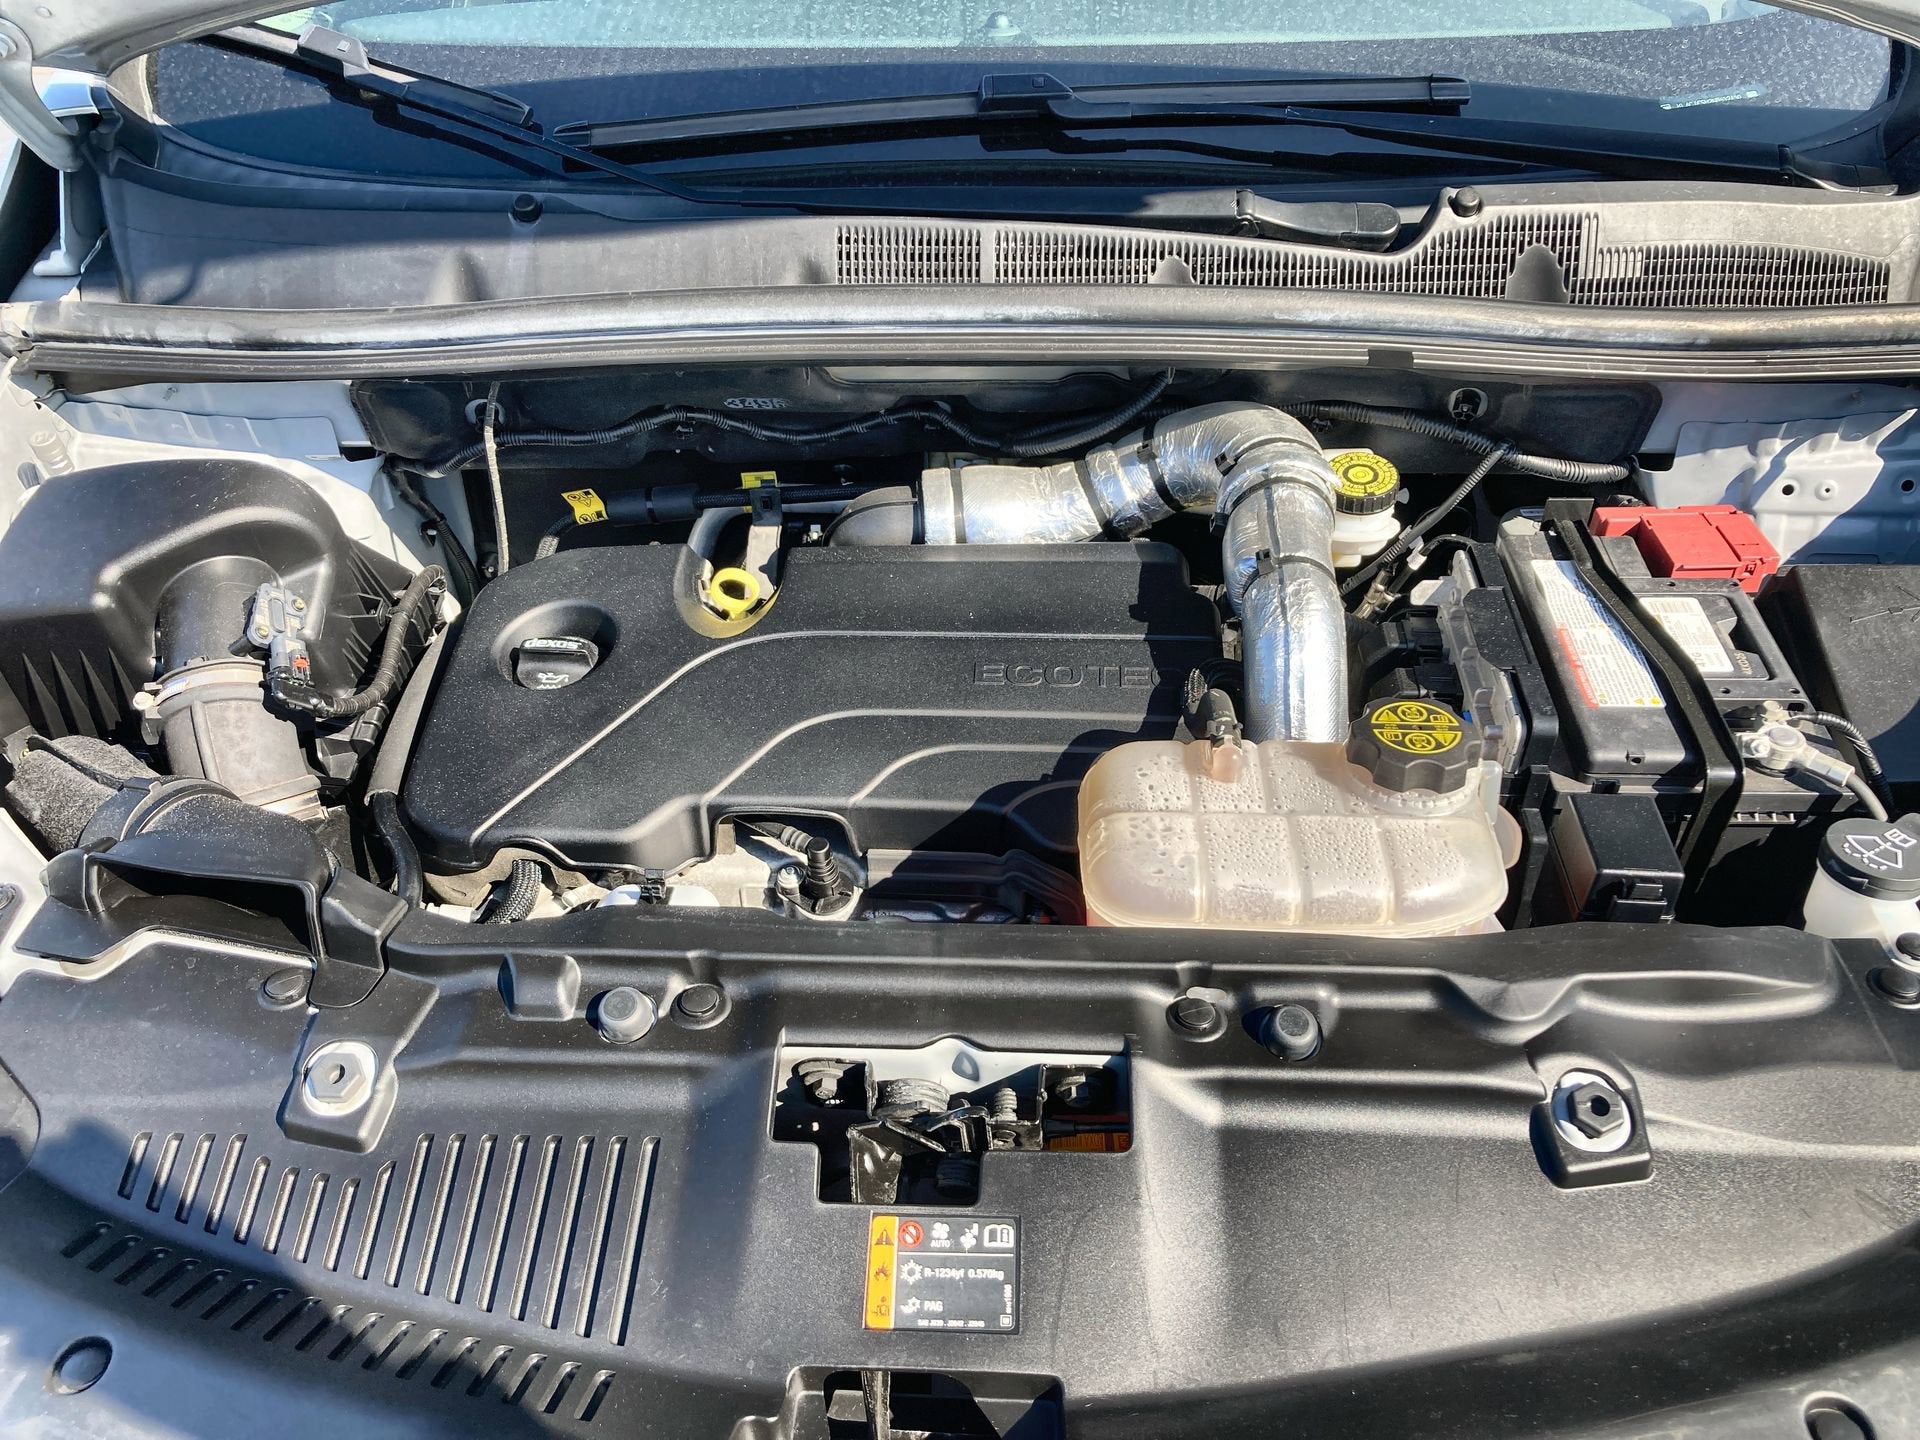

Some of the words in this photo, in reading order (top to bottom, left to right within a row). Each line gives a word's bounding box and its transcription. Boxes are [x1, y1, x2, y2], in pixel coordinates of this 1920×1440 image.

[524, 638, 581, 649] dexos
[930, 1239, 951, 1248] AUTO
[924, 1267, 965, 1280] R-1234yf
[924, 1300, 944, 1312] PAG
